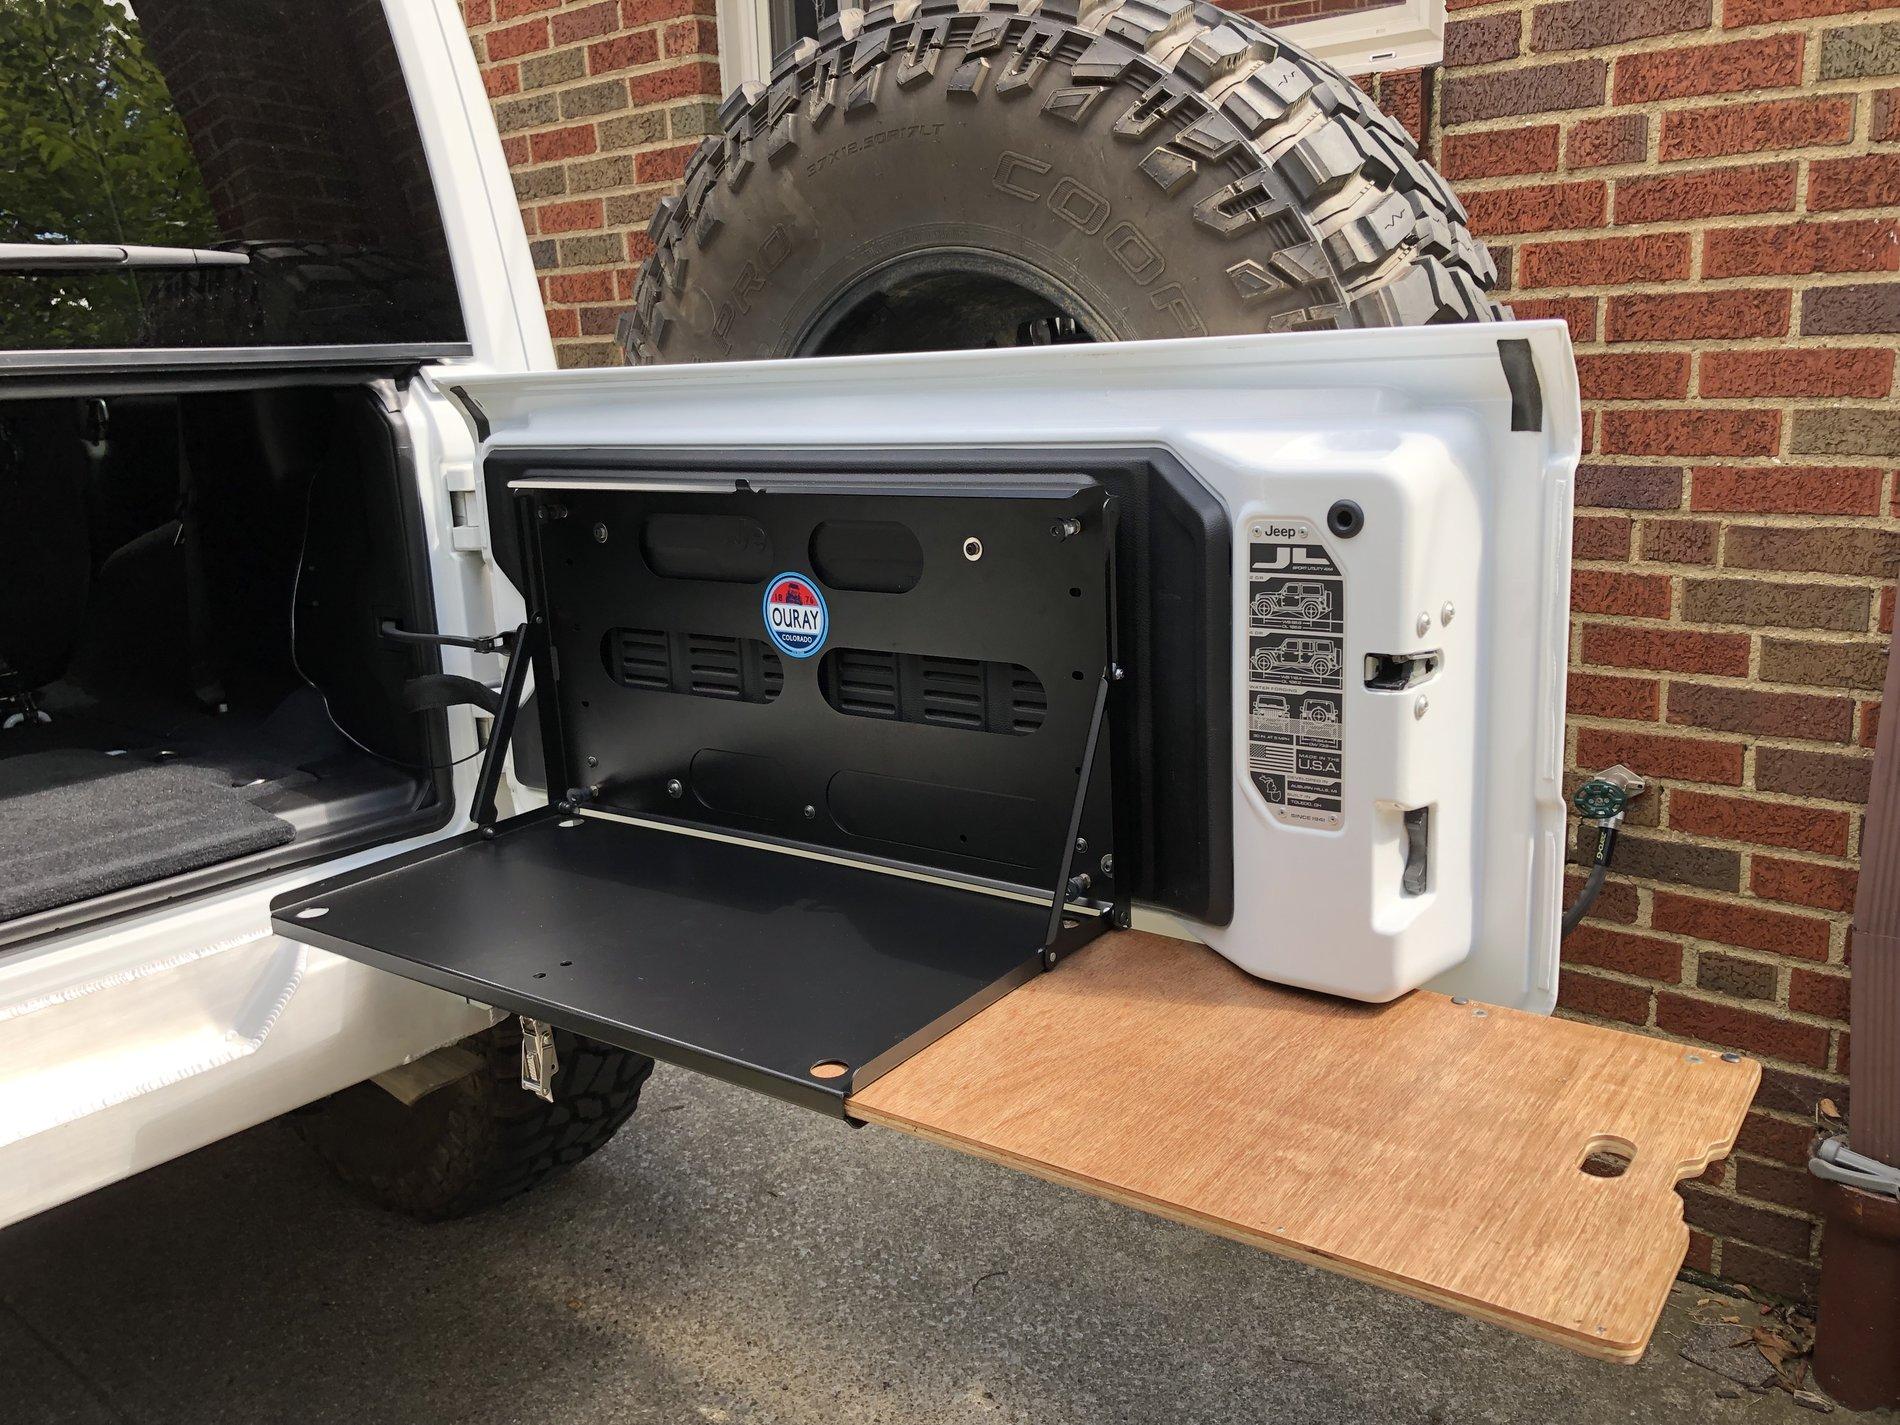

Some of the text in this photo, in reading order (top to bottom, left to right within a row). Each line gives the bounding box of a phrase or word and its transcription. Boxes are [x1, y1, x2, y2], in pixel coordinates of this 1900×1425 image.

[1265, 525, 1296, 539] Jeep
[1252, 547, 1331, 569] JL
[774, 593, 814, 604] 18 76
[772, 607, 819, 630] OURAY
[781, 634, 813, 644] COLORADO
[1298, 758, 1340, 773] U.S.A.
